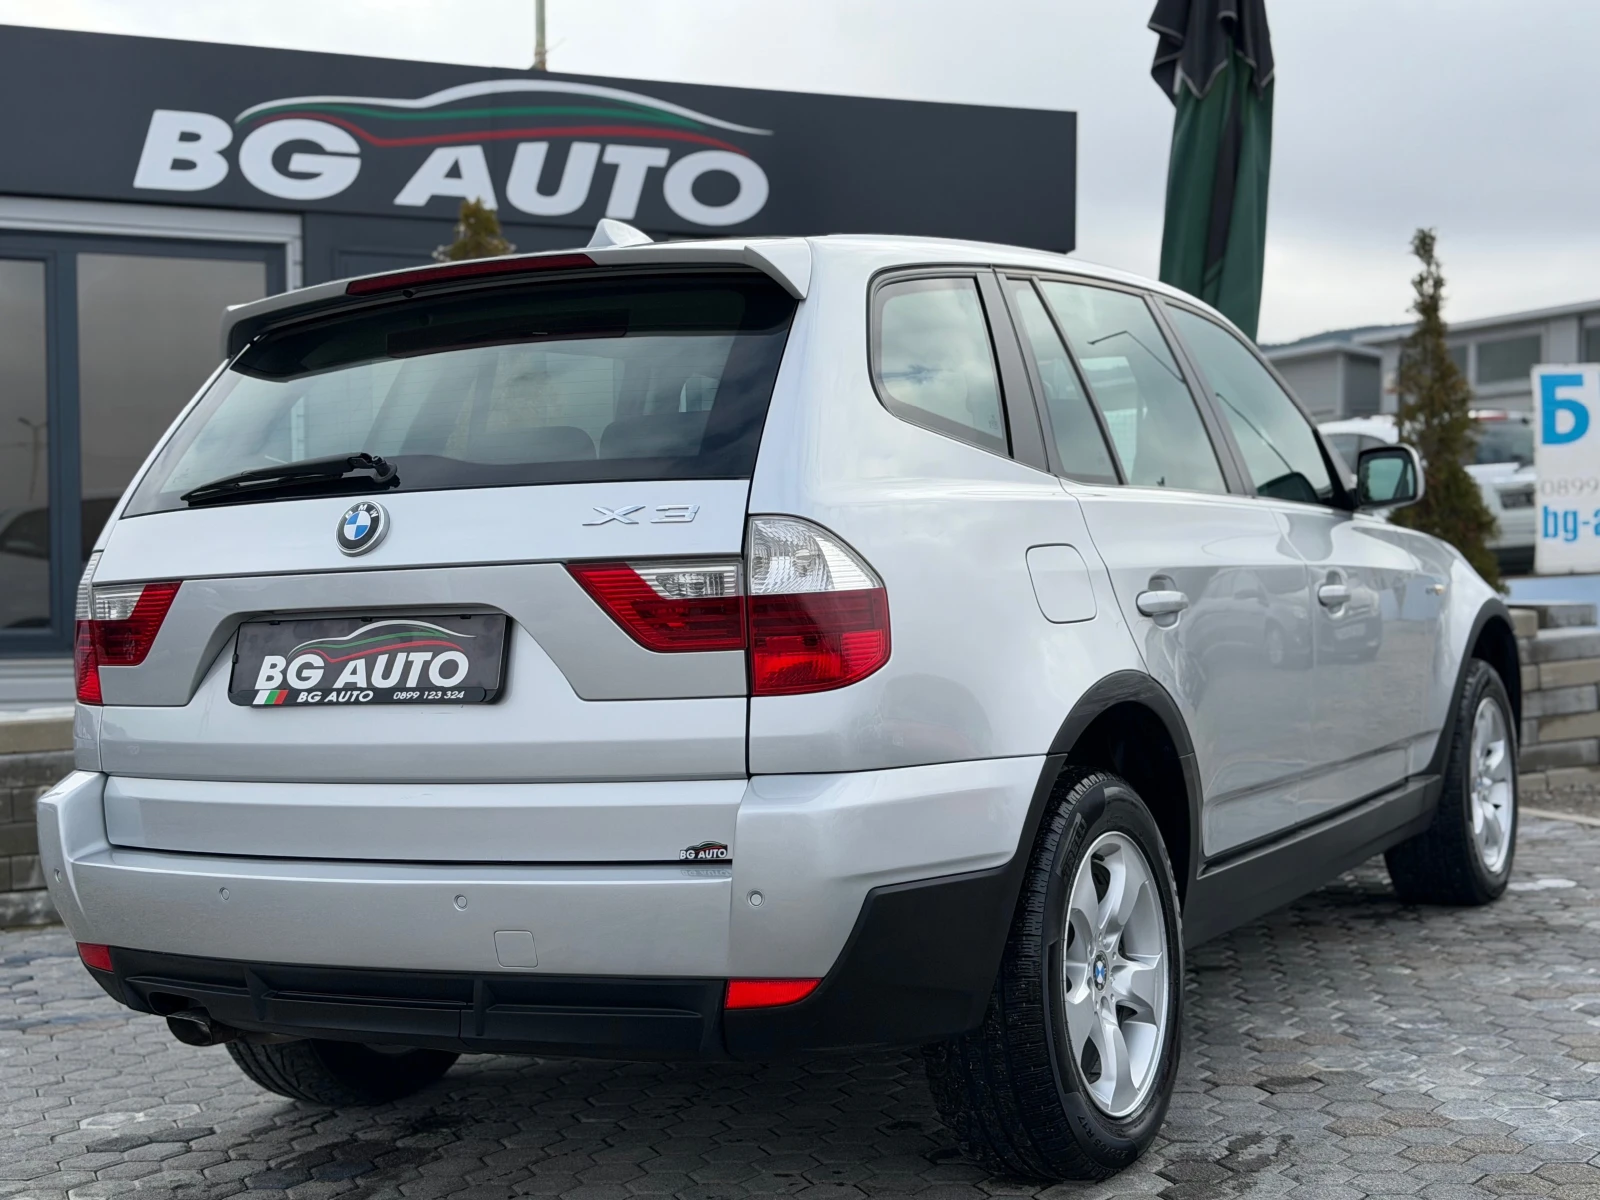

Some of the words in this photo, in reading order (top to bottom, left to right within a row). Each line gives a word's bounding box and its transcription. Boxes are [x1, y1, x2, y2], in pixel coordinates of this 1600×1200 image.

[133, 109, 361, 200] BG
[393, 141, 769, 226] AUTO
[1540, 373, 1600, 445] Б
[345, 503, 379, 519] BMW
[581, 504, 701, 527] X3
[254, 653, 325, 690] BG
[332, 650, 469, 689] AUTO
[296, 691, 323, 703] BG
[324, 690, 374, 702] AUTO
[393, 691, 420, 700] 0899
[423, 690, 442, 700] 123
[443, 690, 466, 699] 324
[680, 850, 695, 859] BG
[697, 848, 727, 859] AUTO
